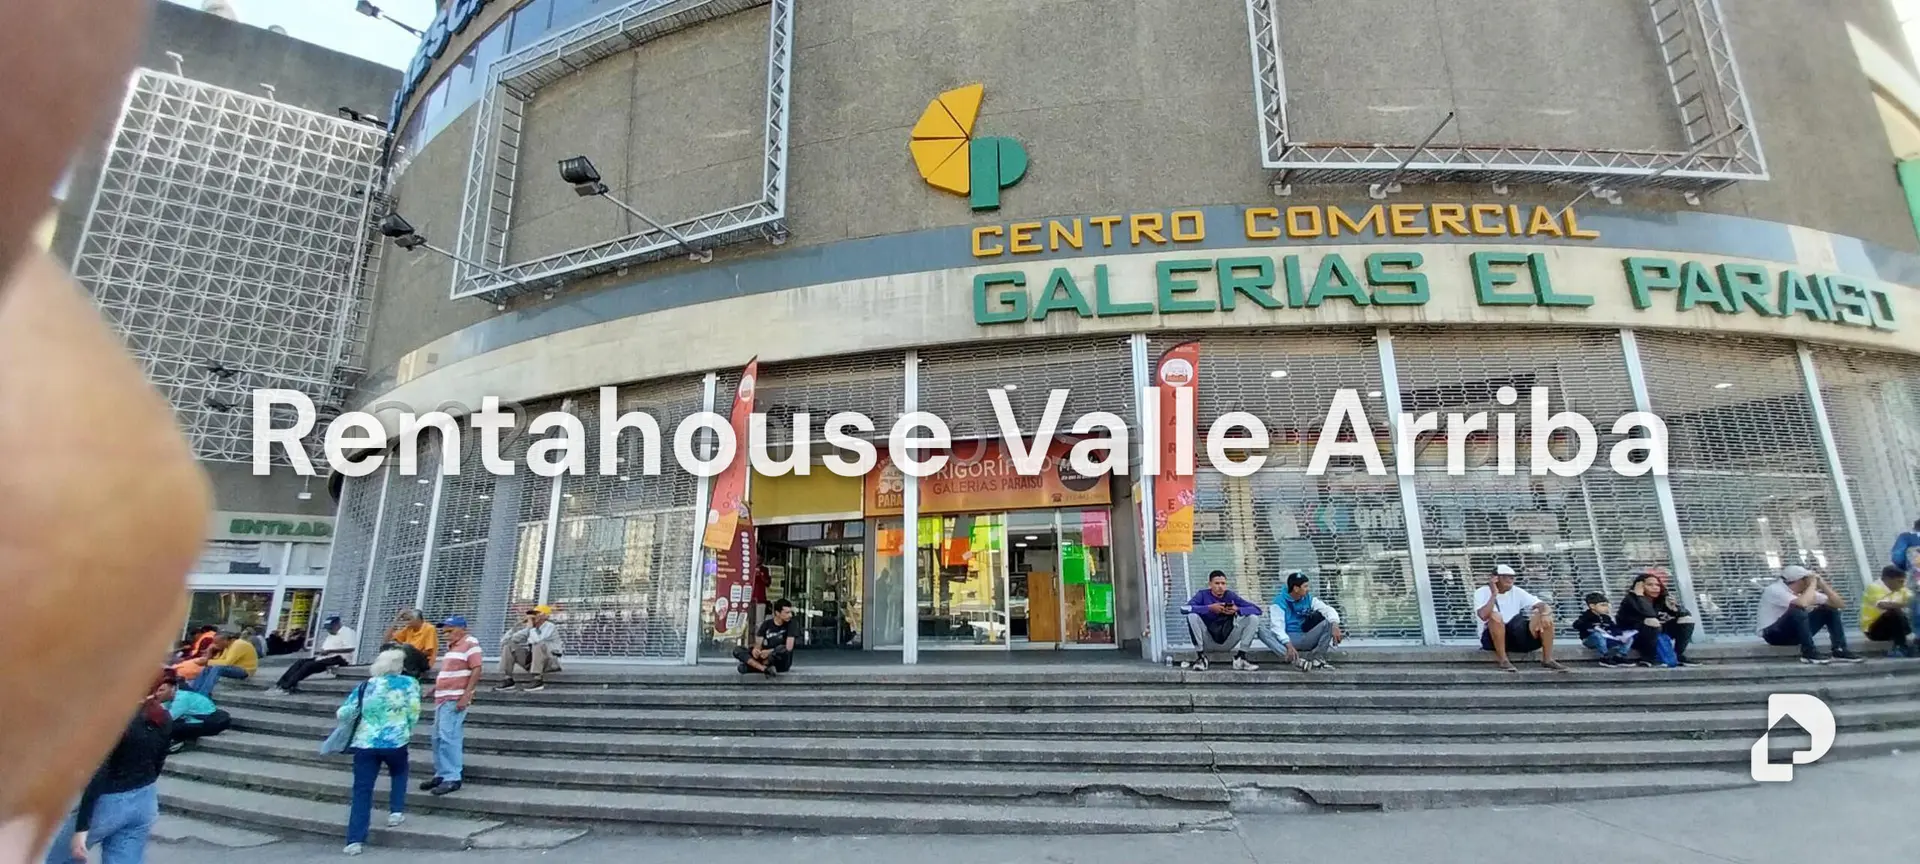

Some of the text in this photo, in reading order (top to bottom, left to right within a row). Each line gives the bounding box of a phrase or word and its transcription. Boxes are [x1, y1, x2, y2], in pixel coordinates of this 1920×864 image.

[972, 203, 1601, 258] CENTRO COMERCIAL
[972, 251, 1899, 332] GALERIAS EL PARAISO
[932, 479, 998, 495] GALERIAS
[229, 518, 334, 538] ENTRAD
